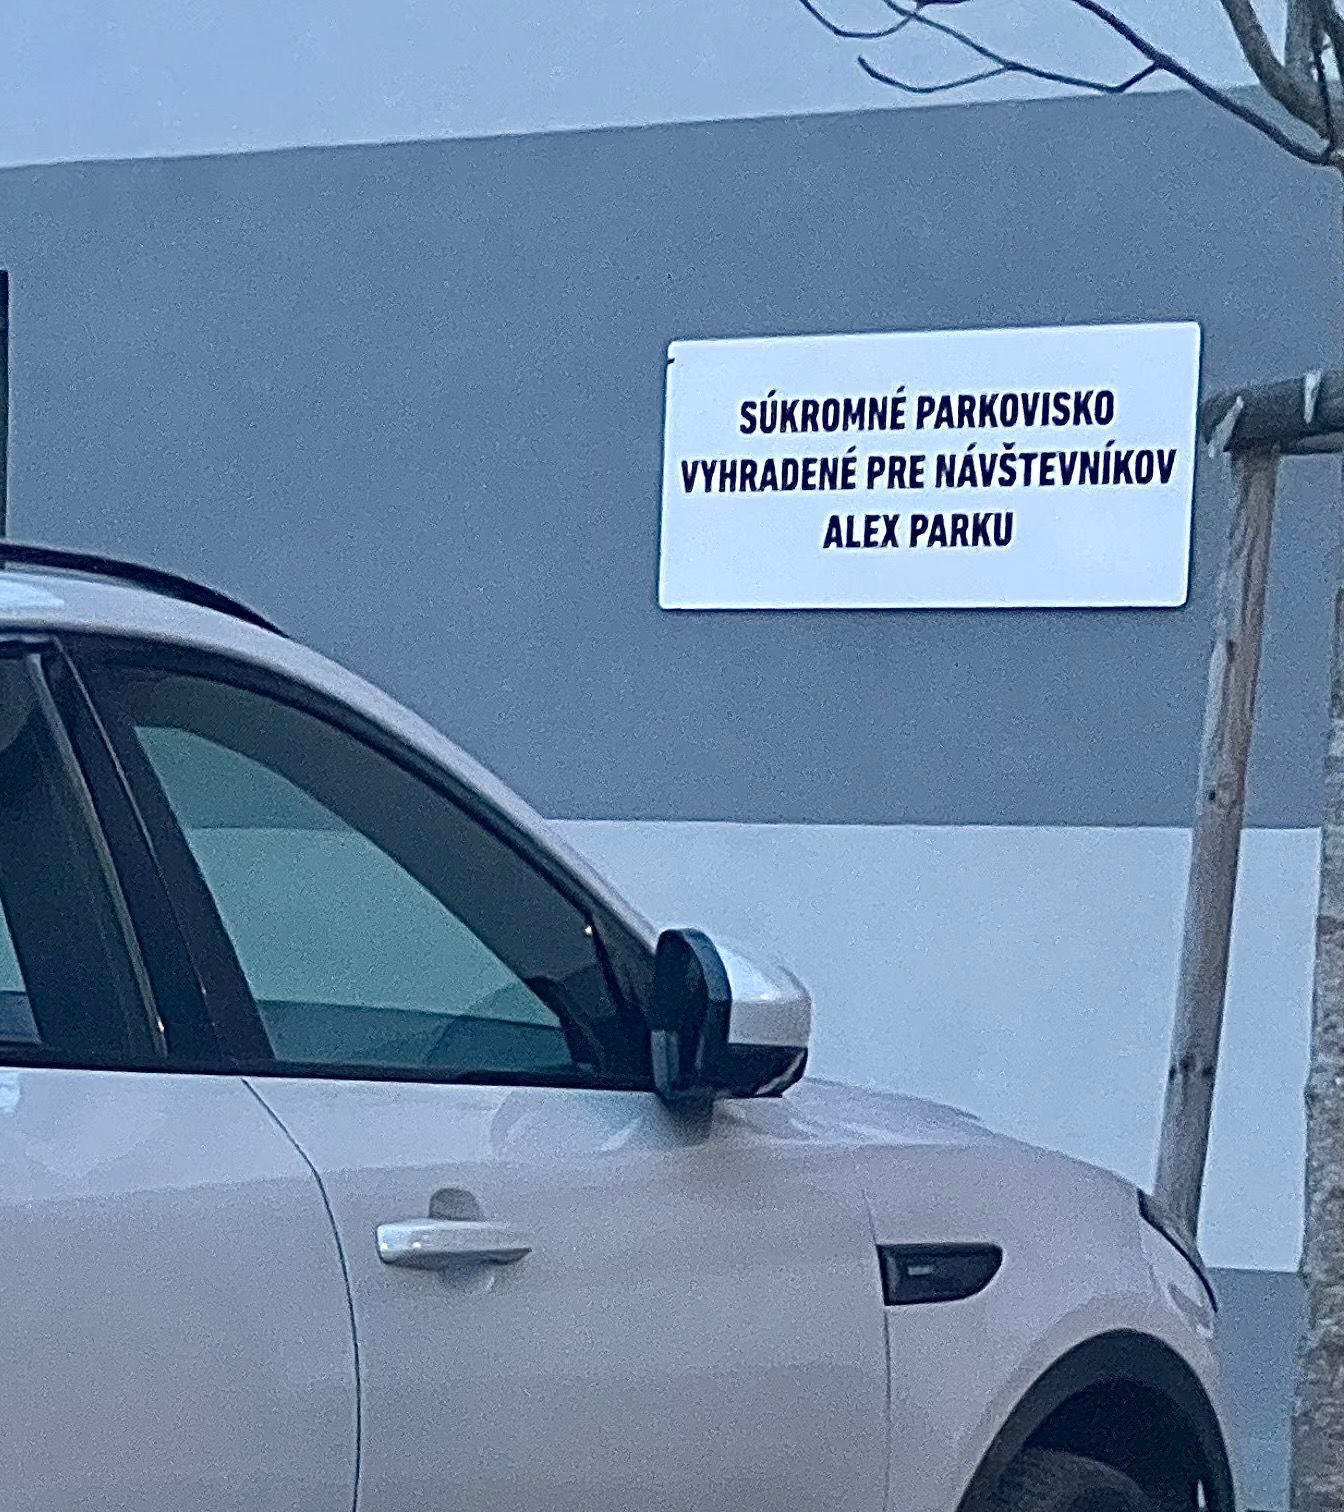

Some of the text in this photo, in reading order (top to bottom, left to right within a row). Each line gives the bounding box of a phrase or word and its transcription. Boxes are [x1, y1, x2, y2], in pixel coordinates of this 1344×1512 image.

[739, 386, 1115, 435] SÚKROMNÉ PARKOVISKO
[680, 440, 1178, 494] VYHRADENÉ PRE NÁVŠTEVNÍKOV
[822, 511, 1014, 549] ALEX PARKU
